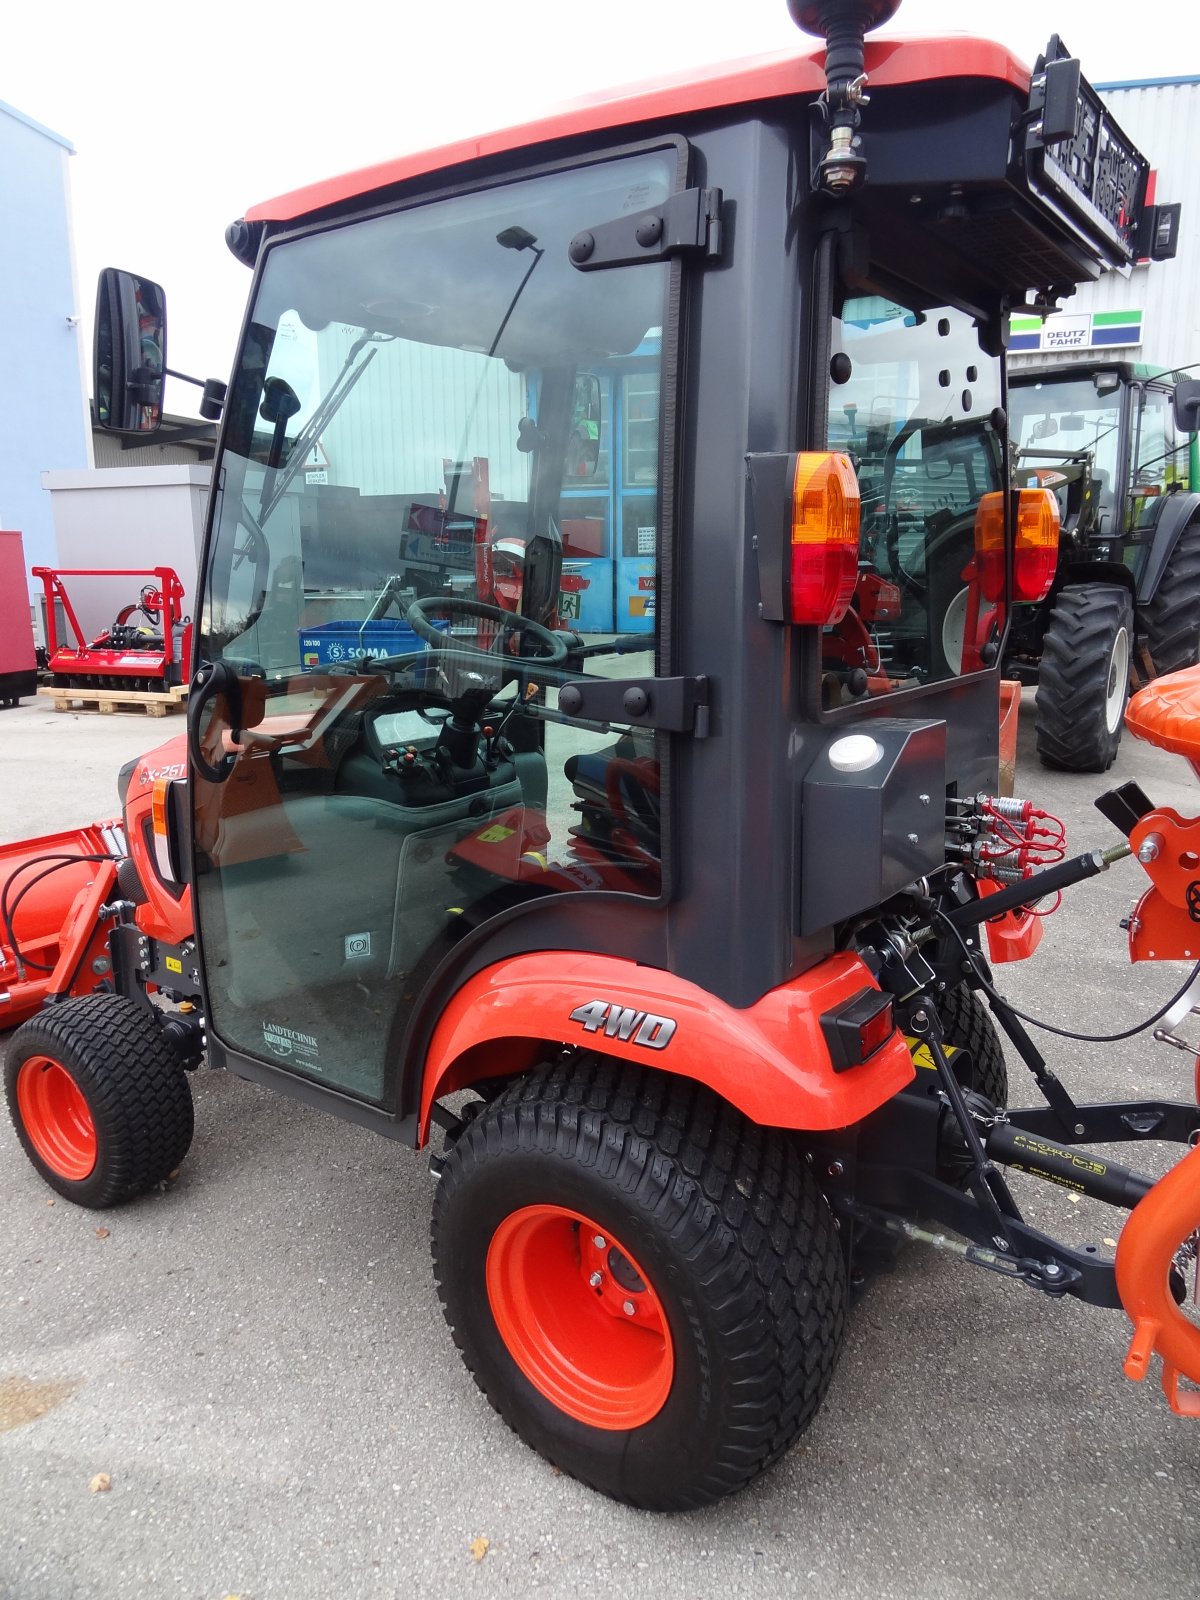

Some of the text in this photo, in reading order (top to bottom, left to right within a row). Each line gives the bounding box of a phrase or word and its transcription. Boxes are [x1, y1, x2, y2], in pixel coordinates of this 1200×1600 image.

[1047, 329, 1086, 339] DEUTZ
[1050, 337, 1082, 346] FAHR
[303, 639, 320, 647] 120/100
[347, 647, 389, 659] SOMA
[568, 999, 678, 1052] 4WD
[262, 1020, 319, 1048] LANDTECHNIK
